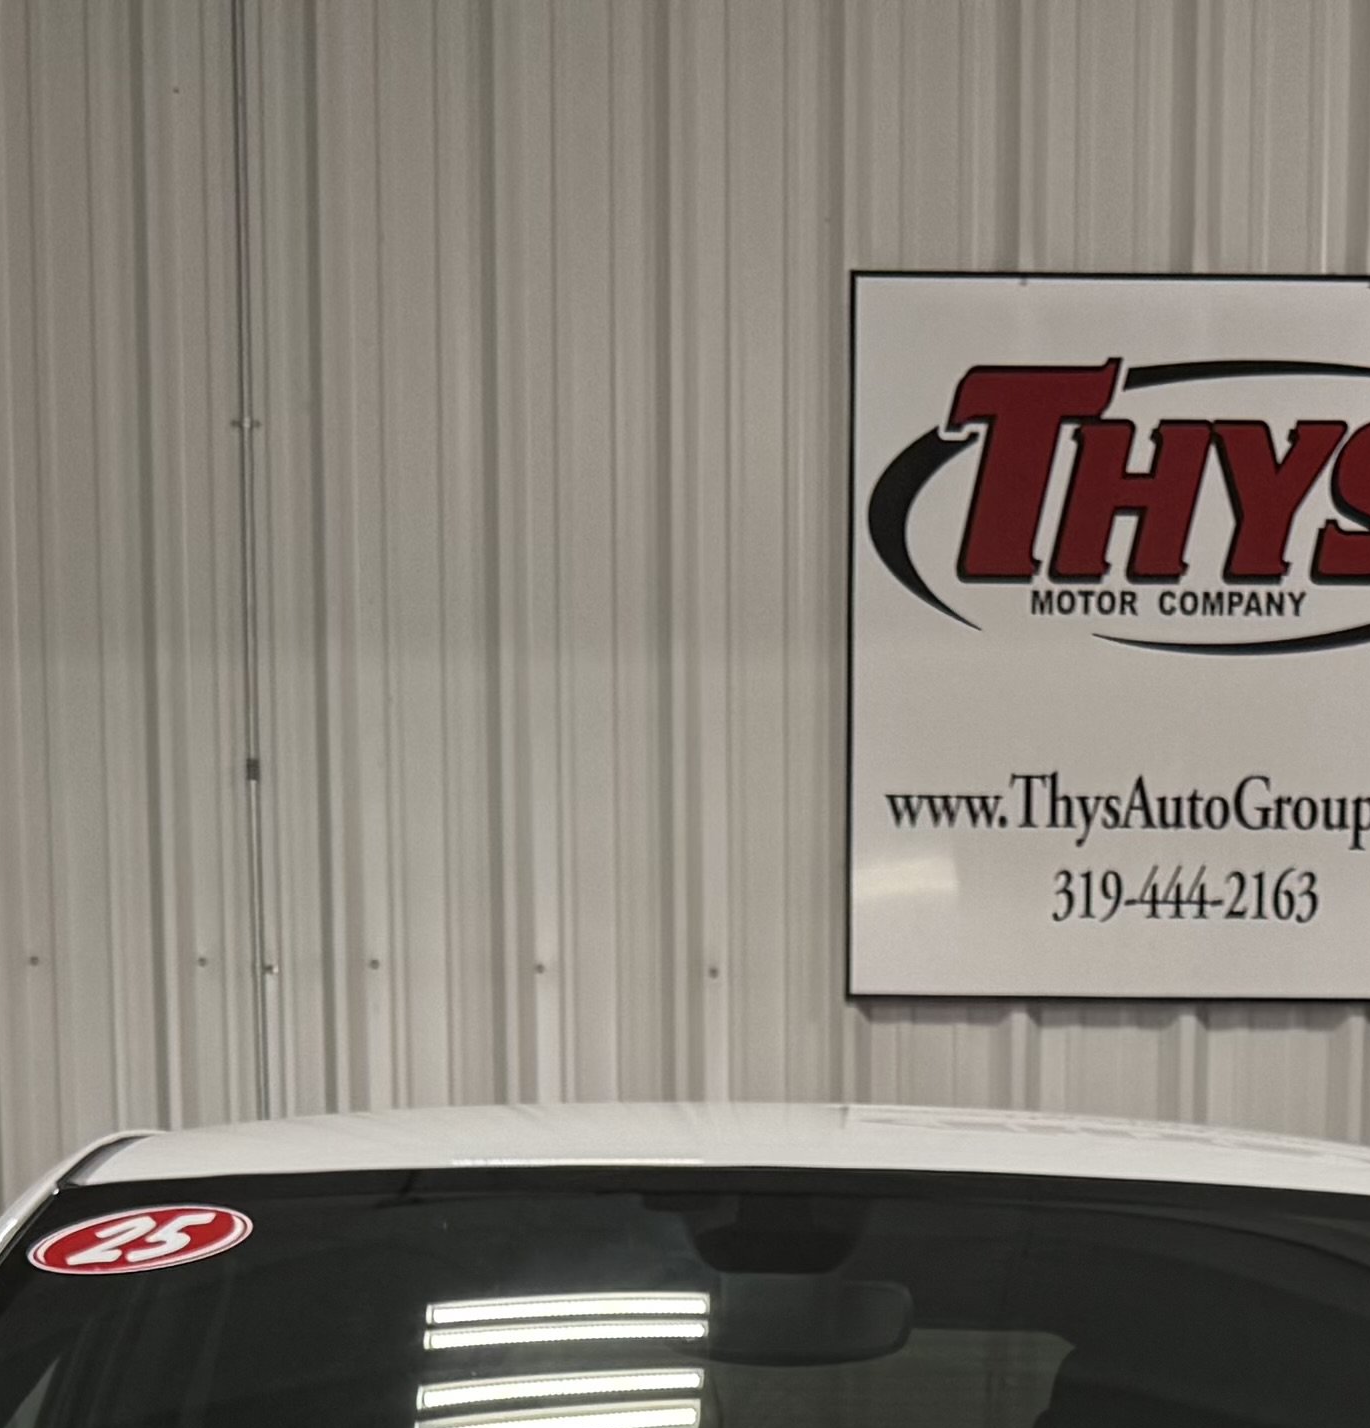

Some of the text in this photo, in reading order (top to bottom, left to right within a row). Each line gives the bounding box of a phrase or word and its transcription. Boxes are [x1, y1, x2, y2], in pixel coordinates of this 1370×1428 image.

[1030, 590, 1307, 617] MOTOR COMPANY
[1052, 865, 1319, 923] 319-444-2163
[66, 1212, 217, 1265] 25
